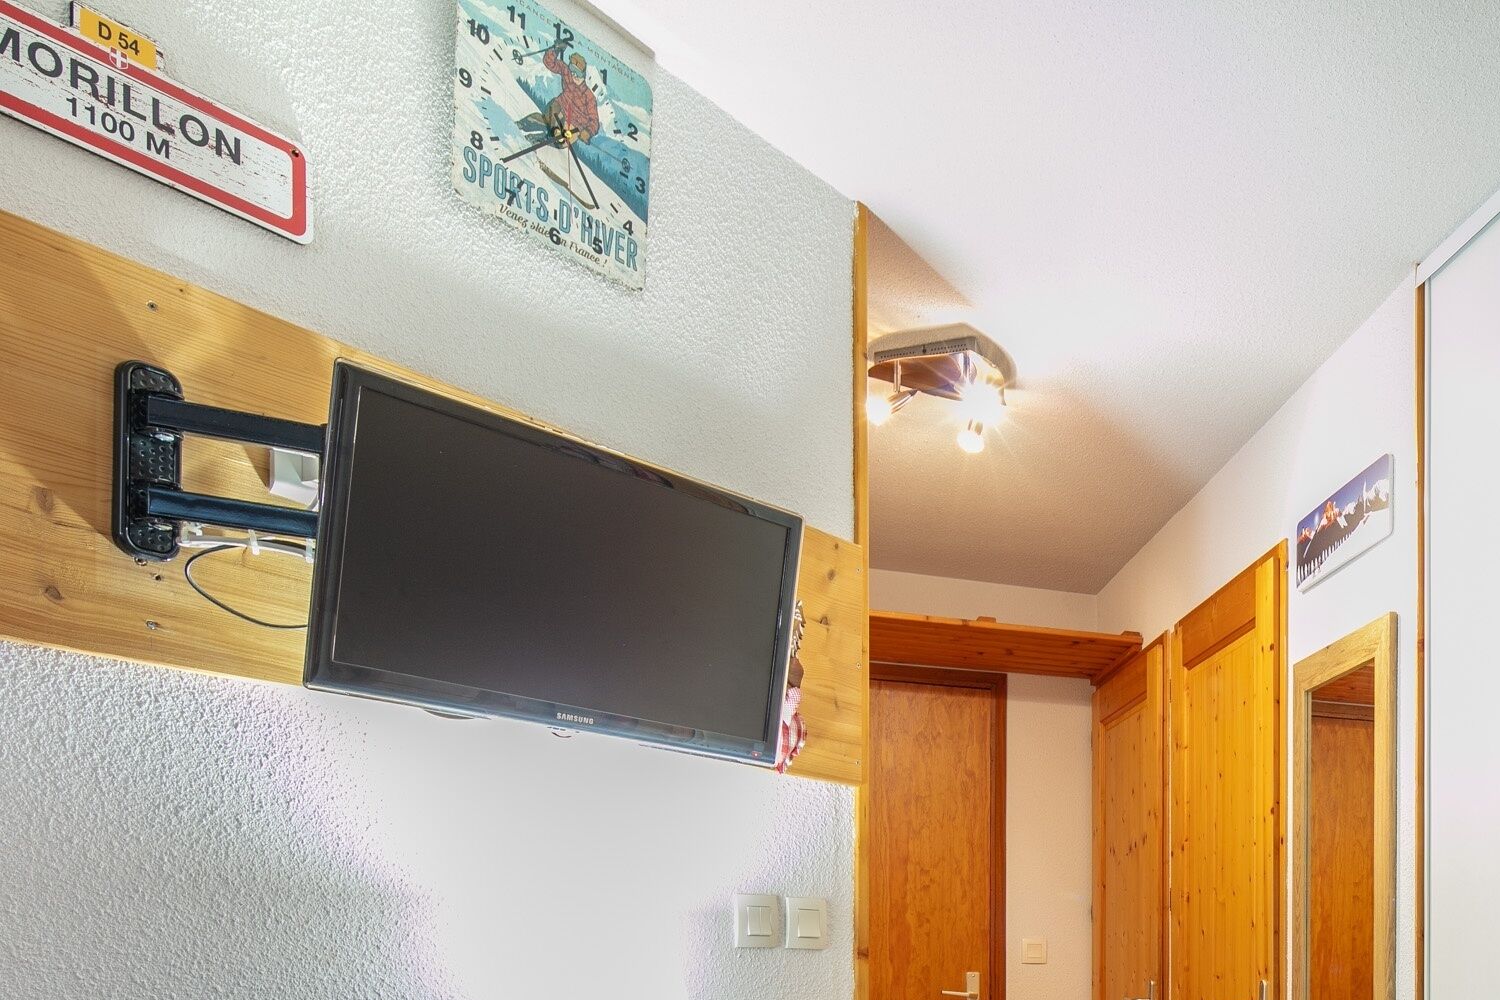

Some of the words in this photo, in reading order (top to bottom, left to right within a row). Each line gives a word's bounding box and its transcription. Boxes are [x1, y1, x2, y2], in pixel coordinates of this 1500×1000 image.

[506, 5, 526, 31] 11
[98, 21, 112, 41] D
[118, 32, 140, 56] 54
[467, 18, 490, 45] 10
[553, 22, 574, 49] 12
[458, 67, 473, 88] 9
[600, 68, 608, 86] 1
[66, 97, 135, 142] 1100
[146, 132, 170, 159] M
[627, 123, 639, 142] 2
[470, 130, 484, 150] 8
[634, 176, 647, 194] 3
[462, 145, 549, 223] SPORTS
[558, 198, 638, 272] D'HIVER
[499, 203, 528, 229] Venez
[530, 221, 550, 238] skie
[569, 241, 601, 265] France
[548, 226, 562, 246] 6
[622, 219, 634, 236] 4
[591, 238, 604, 255] 5
[556, 712, 594, 724] SAMSUNG
